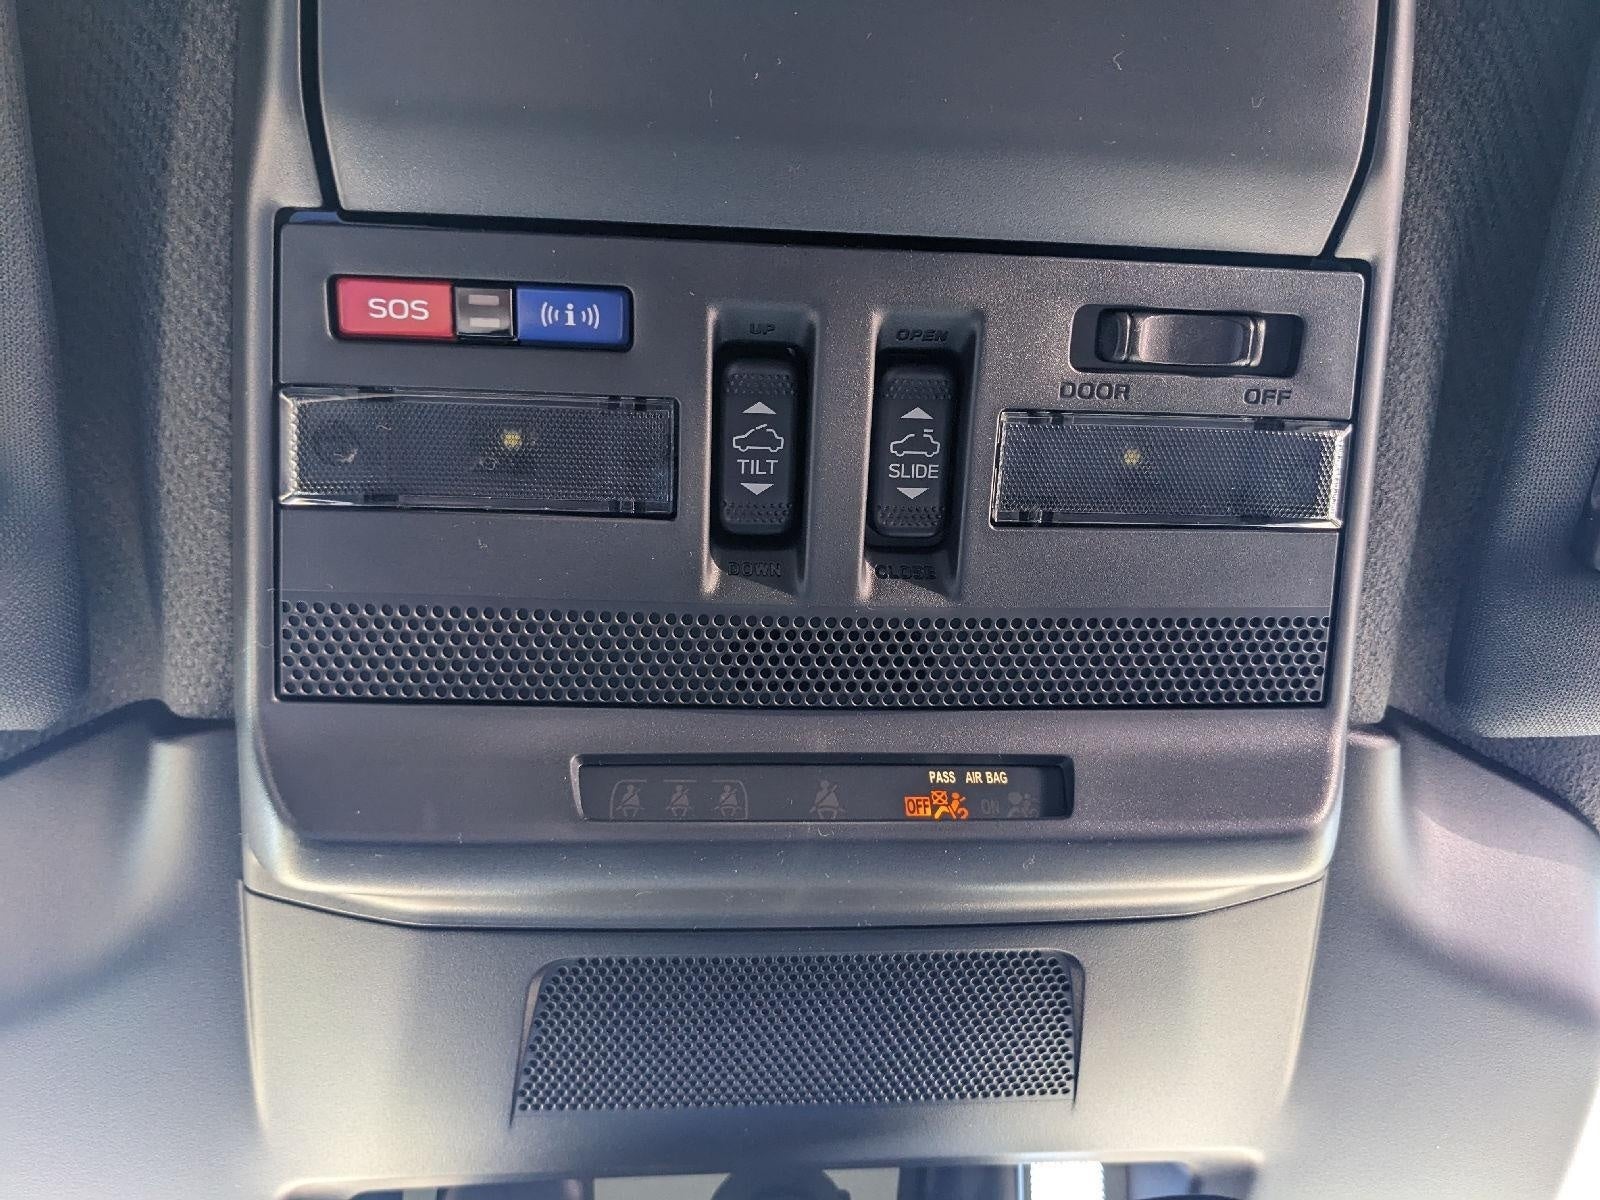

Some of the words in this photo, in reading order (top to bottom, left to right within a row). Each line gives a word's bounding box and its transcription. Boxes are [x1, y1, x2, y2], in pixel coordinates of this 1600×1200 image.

[368, 298, 430, 321] SOS
[750, 322, 776, 335] UP
[896, 328, 949, 342] OPEN
[1059, 381, 1130, 401] DOOR
[1243, 388, 1292, 406] OFF
[737, 459, 779, 475] TILT
[888, 463, 940, 479] SLIDE
[727, 561, 782, 578] DOWN
[874, 564, 937, 580] CLOSE
[929, 770, 957, 784] PASS
[965, 771, 984, 784] AIR
[985, 771, 1009, 785] BAG
[906, 798, 930, 815] OFF
[981, 798, 1001, 815] ON
